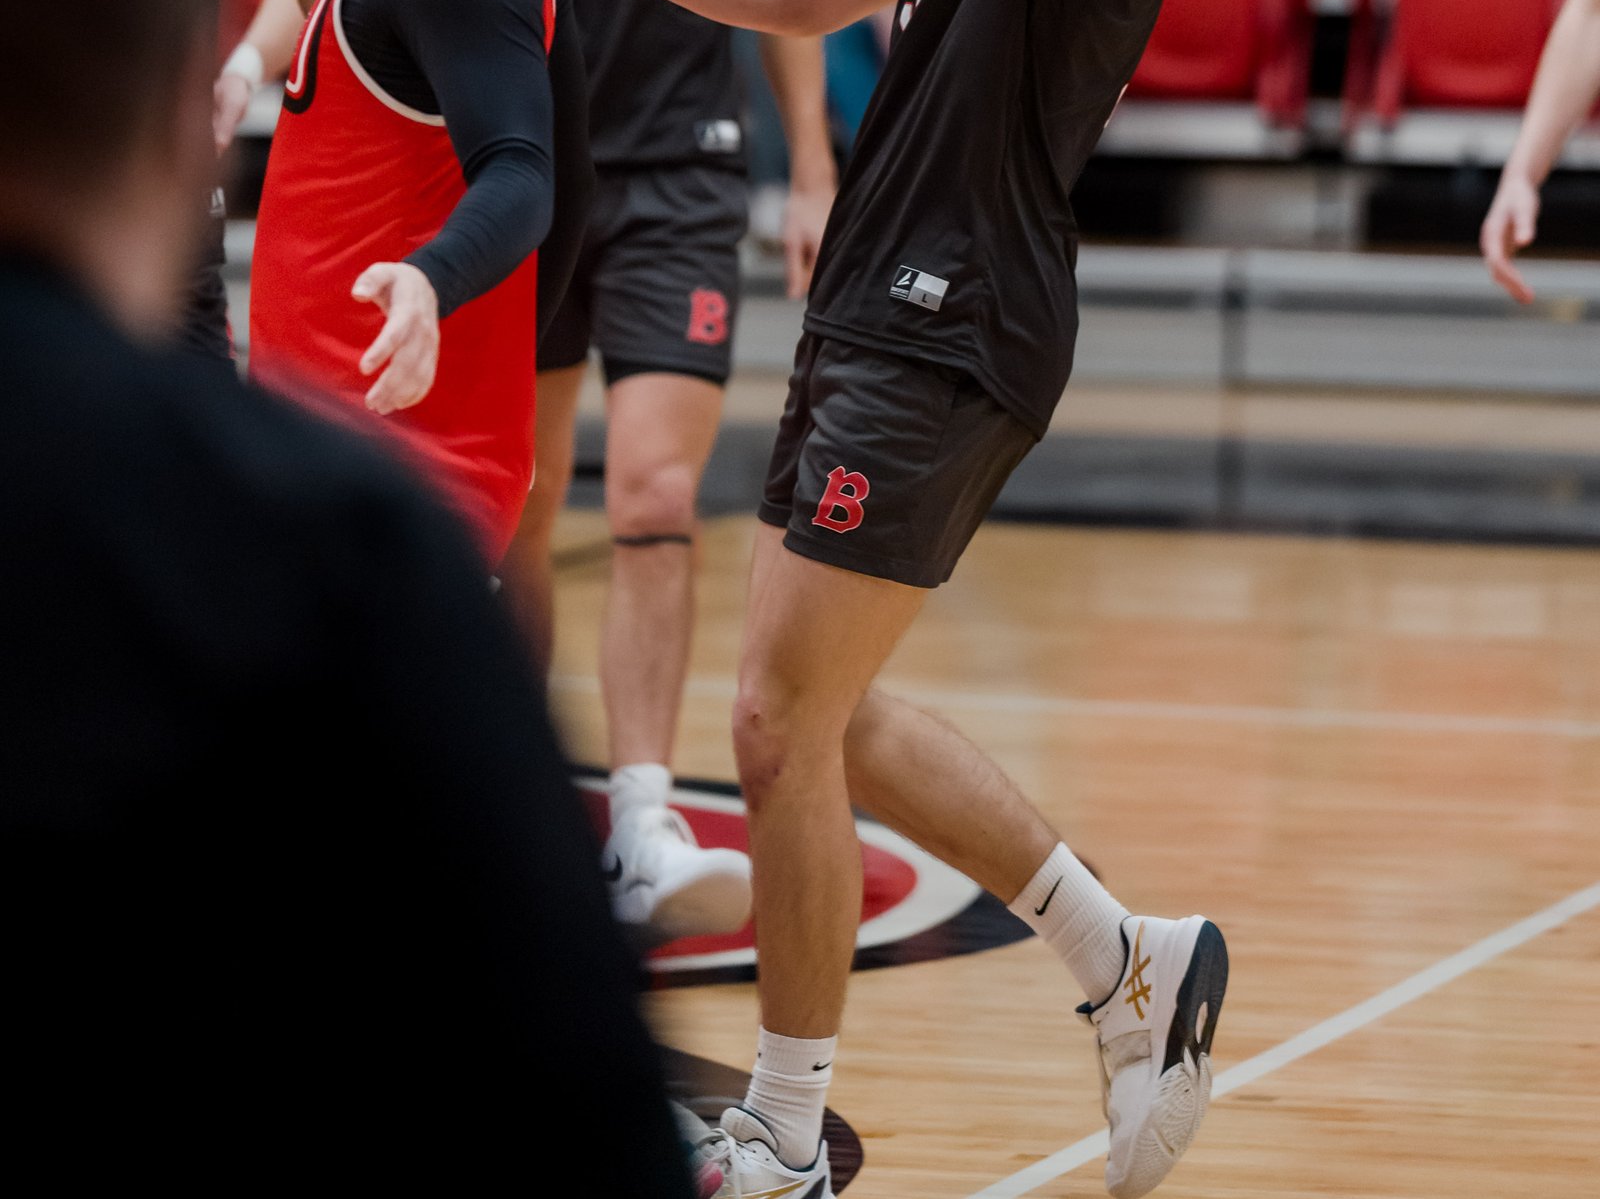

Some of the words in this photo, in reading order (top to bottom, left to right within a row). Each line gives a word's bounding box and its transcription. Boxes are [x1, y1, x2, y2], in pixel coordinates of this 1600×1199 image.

[687, 289, 729, 345] B
[921, 293, 928, 303] L
[811, 465, 870, 534] B
